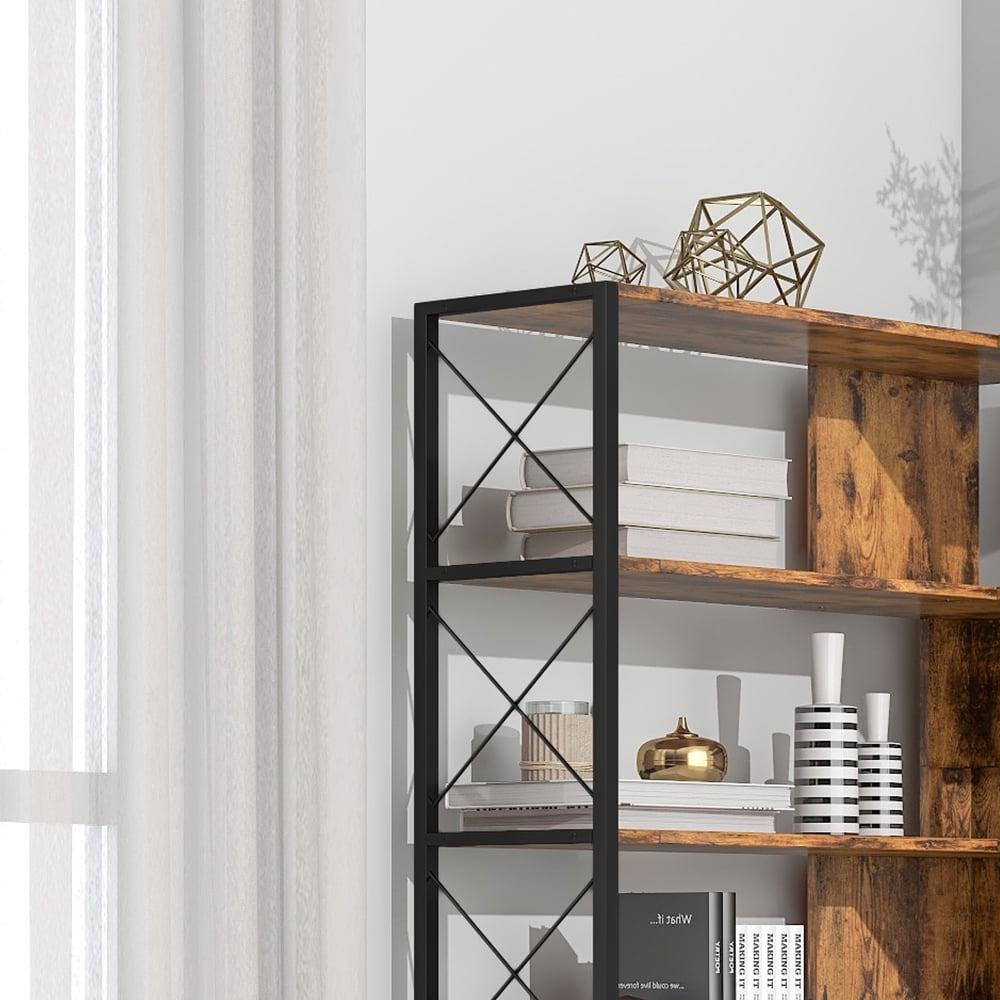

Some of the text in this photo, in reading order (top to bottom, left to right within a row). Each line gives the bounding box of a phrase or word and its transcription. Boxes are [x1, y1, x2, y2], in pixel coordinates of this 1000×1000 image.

[739, 978, 746, 989] IT
[753, 978, 760, 989] IT
[767, 978, 774, 989] IT
[781, 978, 788, 989] IT
[795, 978, 802, 989] IT
